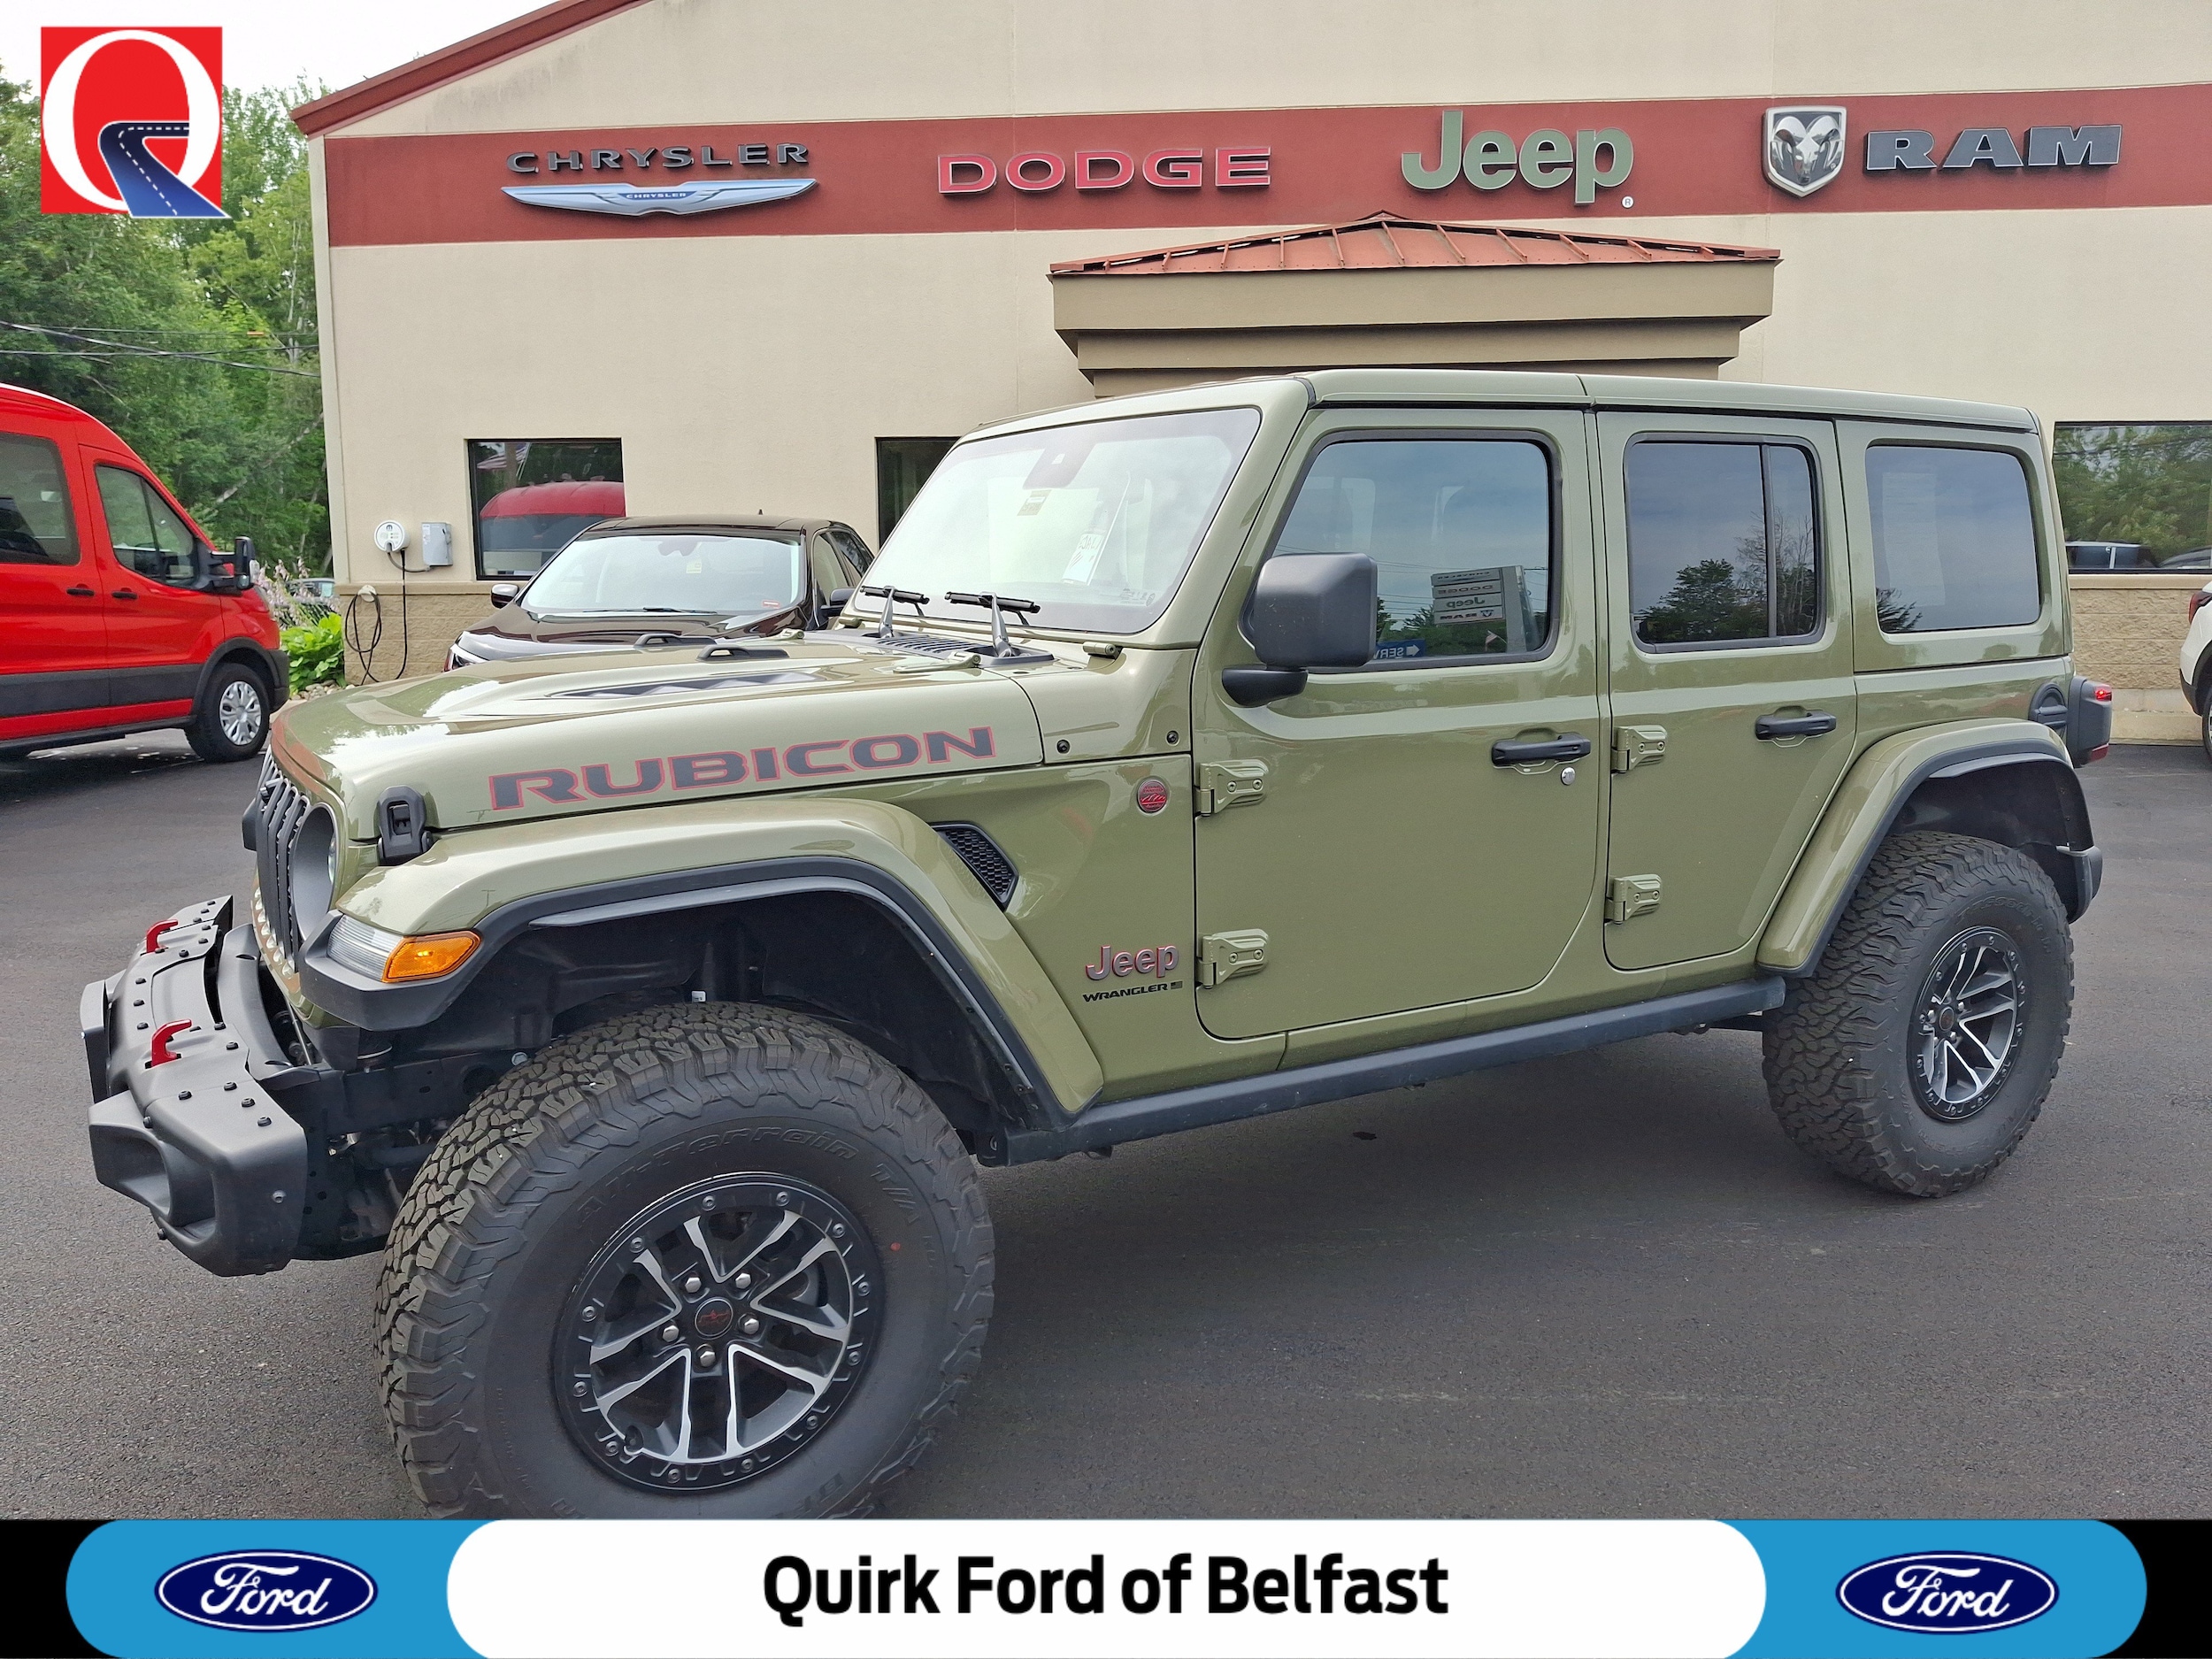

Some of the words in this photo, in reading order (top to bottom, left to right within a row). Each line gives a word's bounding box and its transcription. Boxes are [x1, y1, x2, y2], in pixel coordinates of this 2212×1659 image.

[506, 142, 810, 173] CHRYSLER
[1401, 110, 1634, 205] Jeep
[1863, 124, 2123, 172] RAM
[937, 146, 1271, 194] DODGE
[626, 191, 687, 200] CHRYSLER
[488, 726, 996, 810] RUBICON
[1085, 944, 1179, 981] Jeep
[1082, 983, 1168, 1002] WRANGLER
